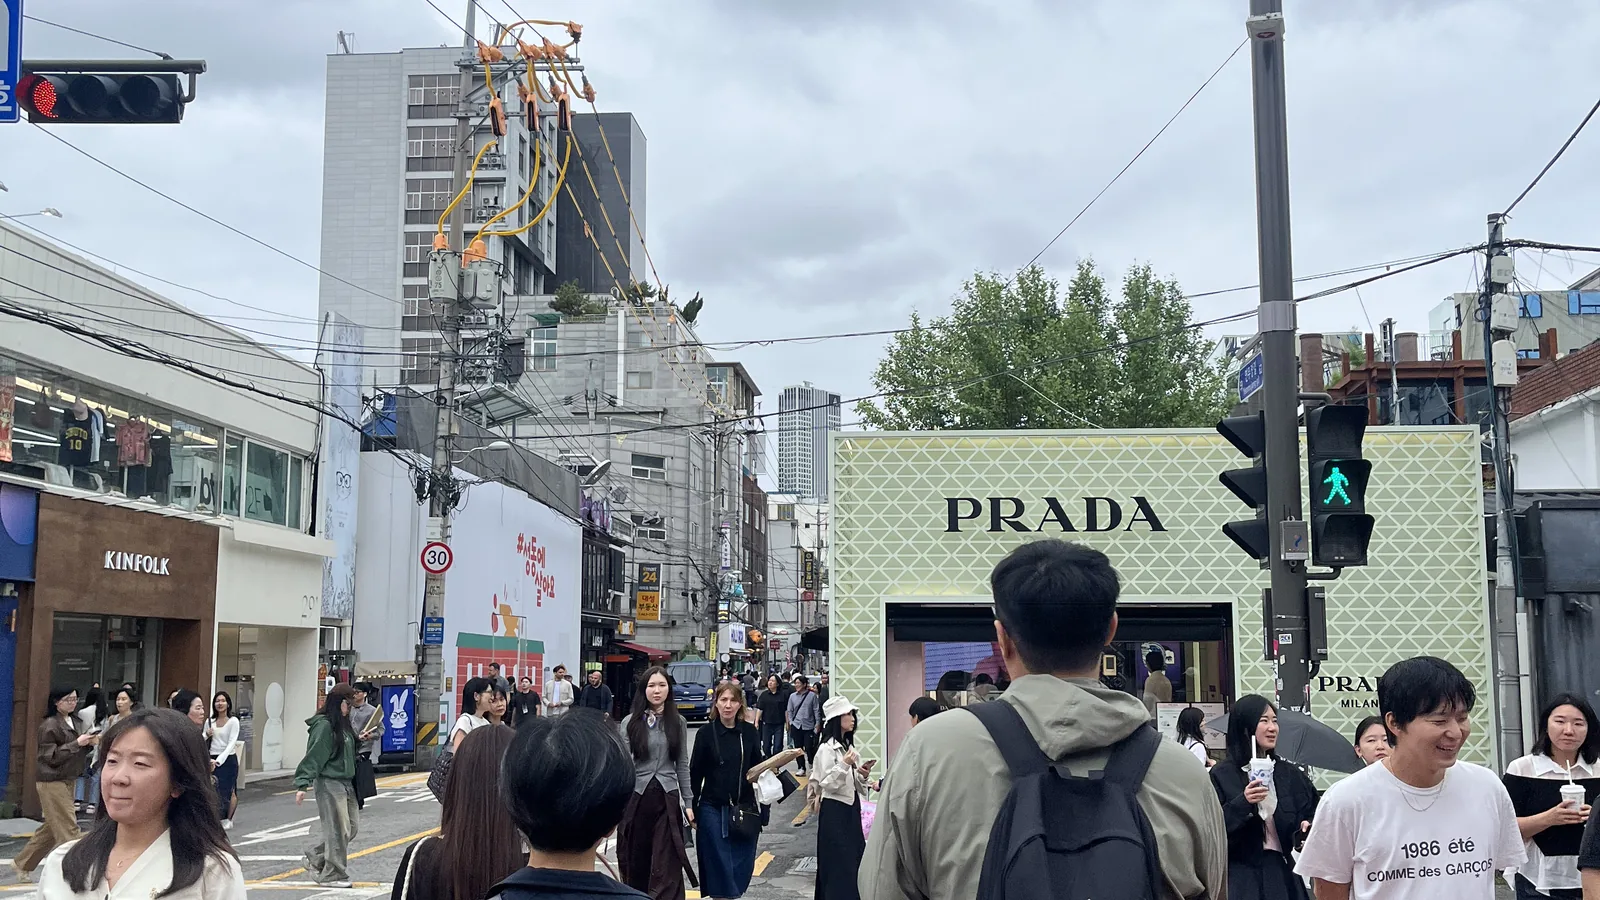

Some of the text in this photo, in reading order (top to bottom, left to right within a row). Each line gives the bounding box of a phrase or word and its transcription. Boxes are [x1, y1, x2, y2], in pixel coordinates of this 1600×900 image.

[70, 439, 82, 451] 10
[943, 496, 1169, 532] PRADA
[427, 550, 447, 566] 30
[516, 532, 546, 577] #성동에
[103, 550, 170, 576] KINFOLK
[642, 571, 658, 583] 24
[534, 571, 555, 607] 살아요
[638, 603, 659, 612] 부동산
[641, 595, 656, 604] 대성
[1400, 837, 1475, 859] 1986 été
[1367, 867, 1416, 882] COMME
[1418, 866, 1441, 878] des
